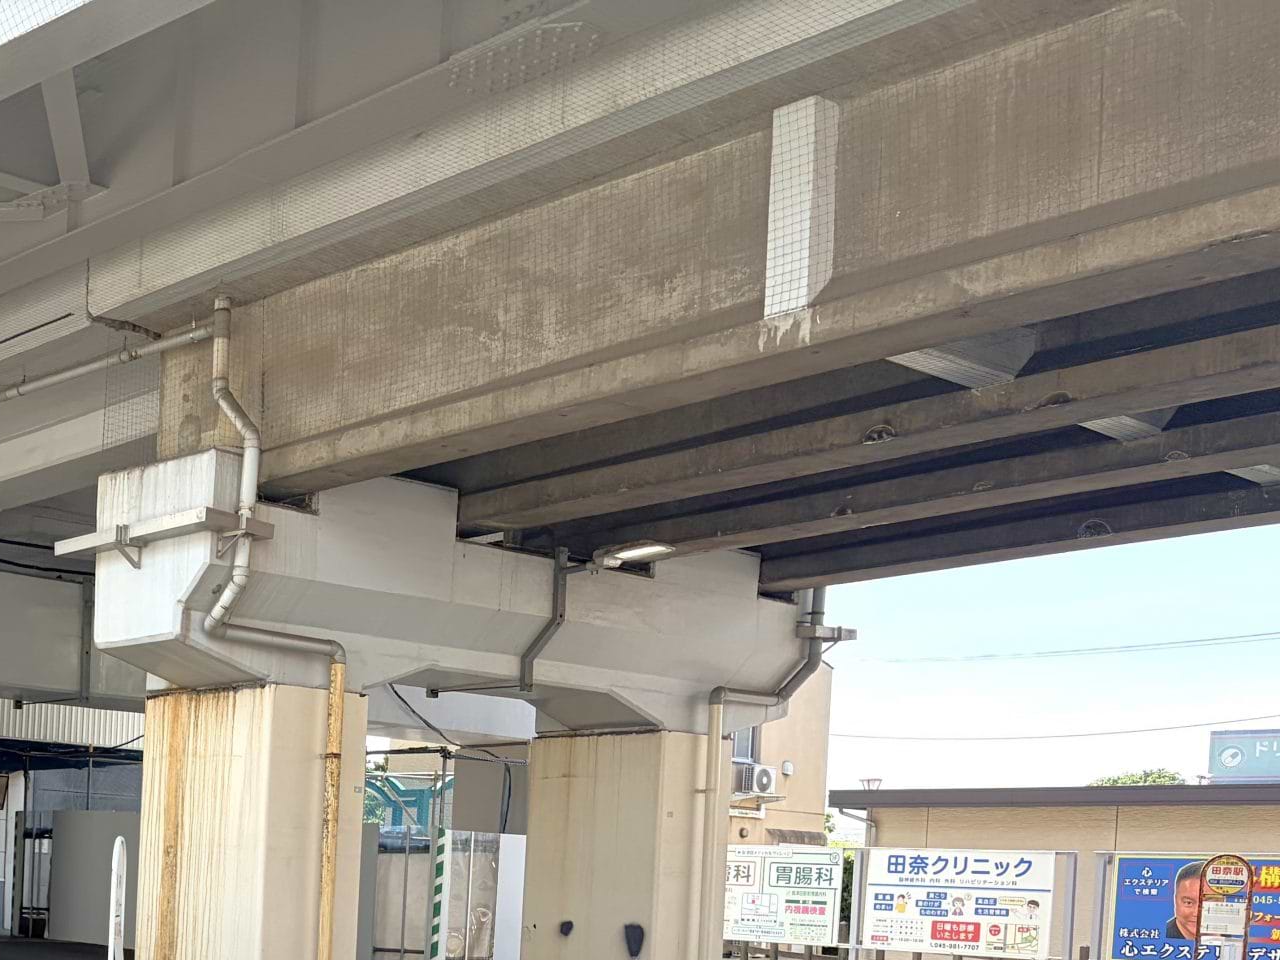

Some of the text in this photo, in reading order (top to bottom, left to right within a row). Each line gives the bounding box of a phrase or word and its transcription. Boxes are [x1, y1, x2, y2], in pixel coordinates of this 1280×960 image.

[887, 854, 1033, 878] 田奈クリニック
[1211, 866, 1244, 876] 田奈駅
[726, 864, 752, 883] 科
[776, 866, 834, 886] 胃腸科
[1141, 867, 1152, 877] 心
[1124, 878, 1169, 887] エクステリア
[936, 932, 974, 941] いたします
[1119, 927, 1160, 939] 株式会社
